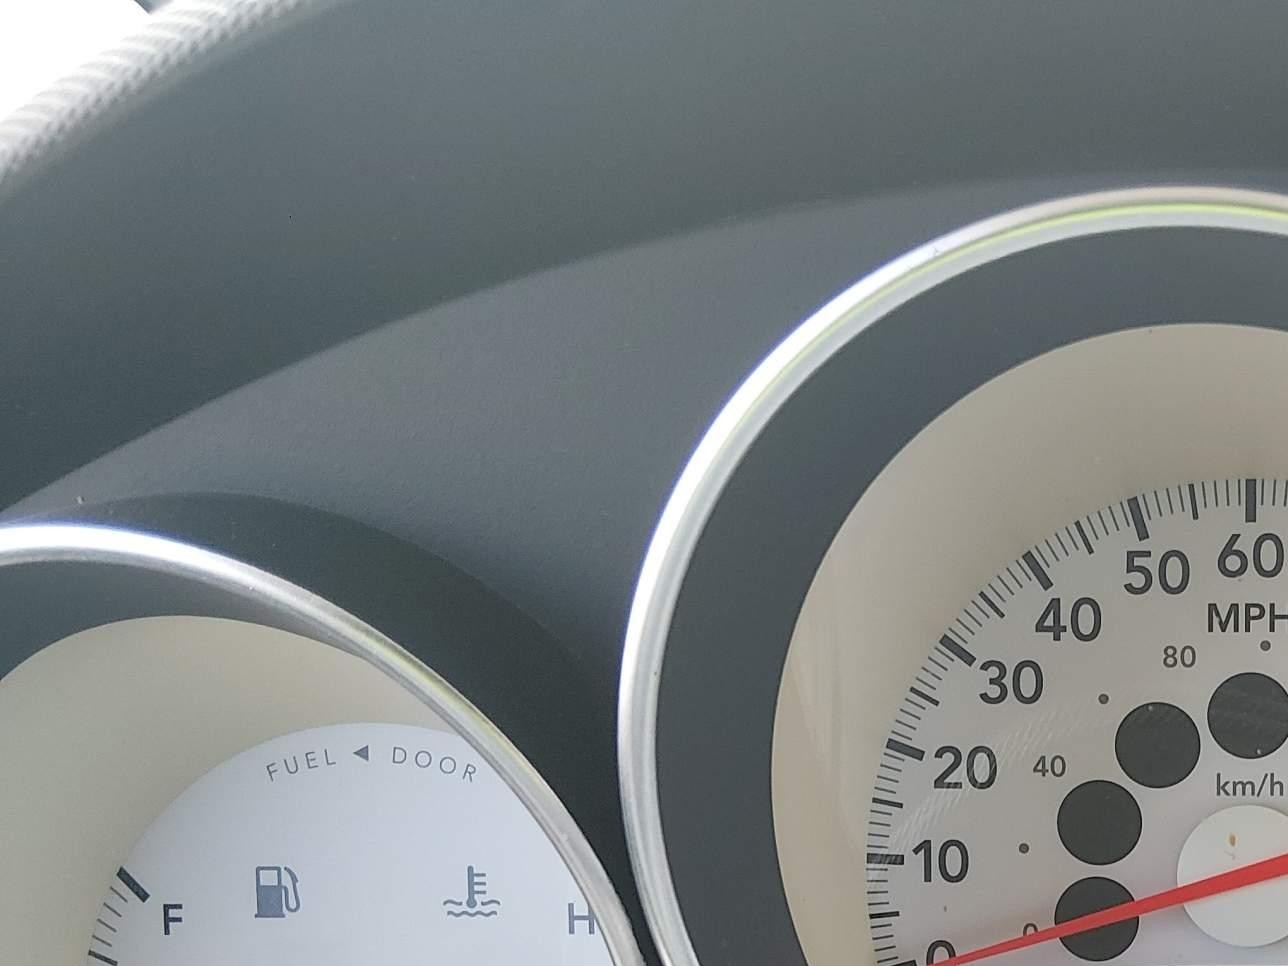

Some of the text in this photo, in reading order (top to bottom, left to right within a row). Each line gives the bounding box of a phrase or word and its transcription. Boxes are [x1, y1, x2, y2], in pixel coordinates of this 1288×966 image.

[1123, 549, 1191, 596] 50
[1217, 532, 1285, 579] 60
[1034, 596, 1102, 643] 40
[1162, 645, 1197, 669] 80
[978, 659, 1044, 705] 30
[265, 745, 477, 782] FUEL DOOR
[933, 745, 998, 790] 20
[1032, 754, 1067, 778] 40
[1216, 772, 1284, 798] km/h
[911, 839, 970, 884] 10
[162, 903, 183, 936] F
[568, 903, 595, 935] H
